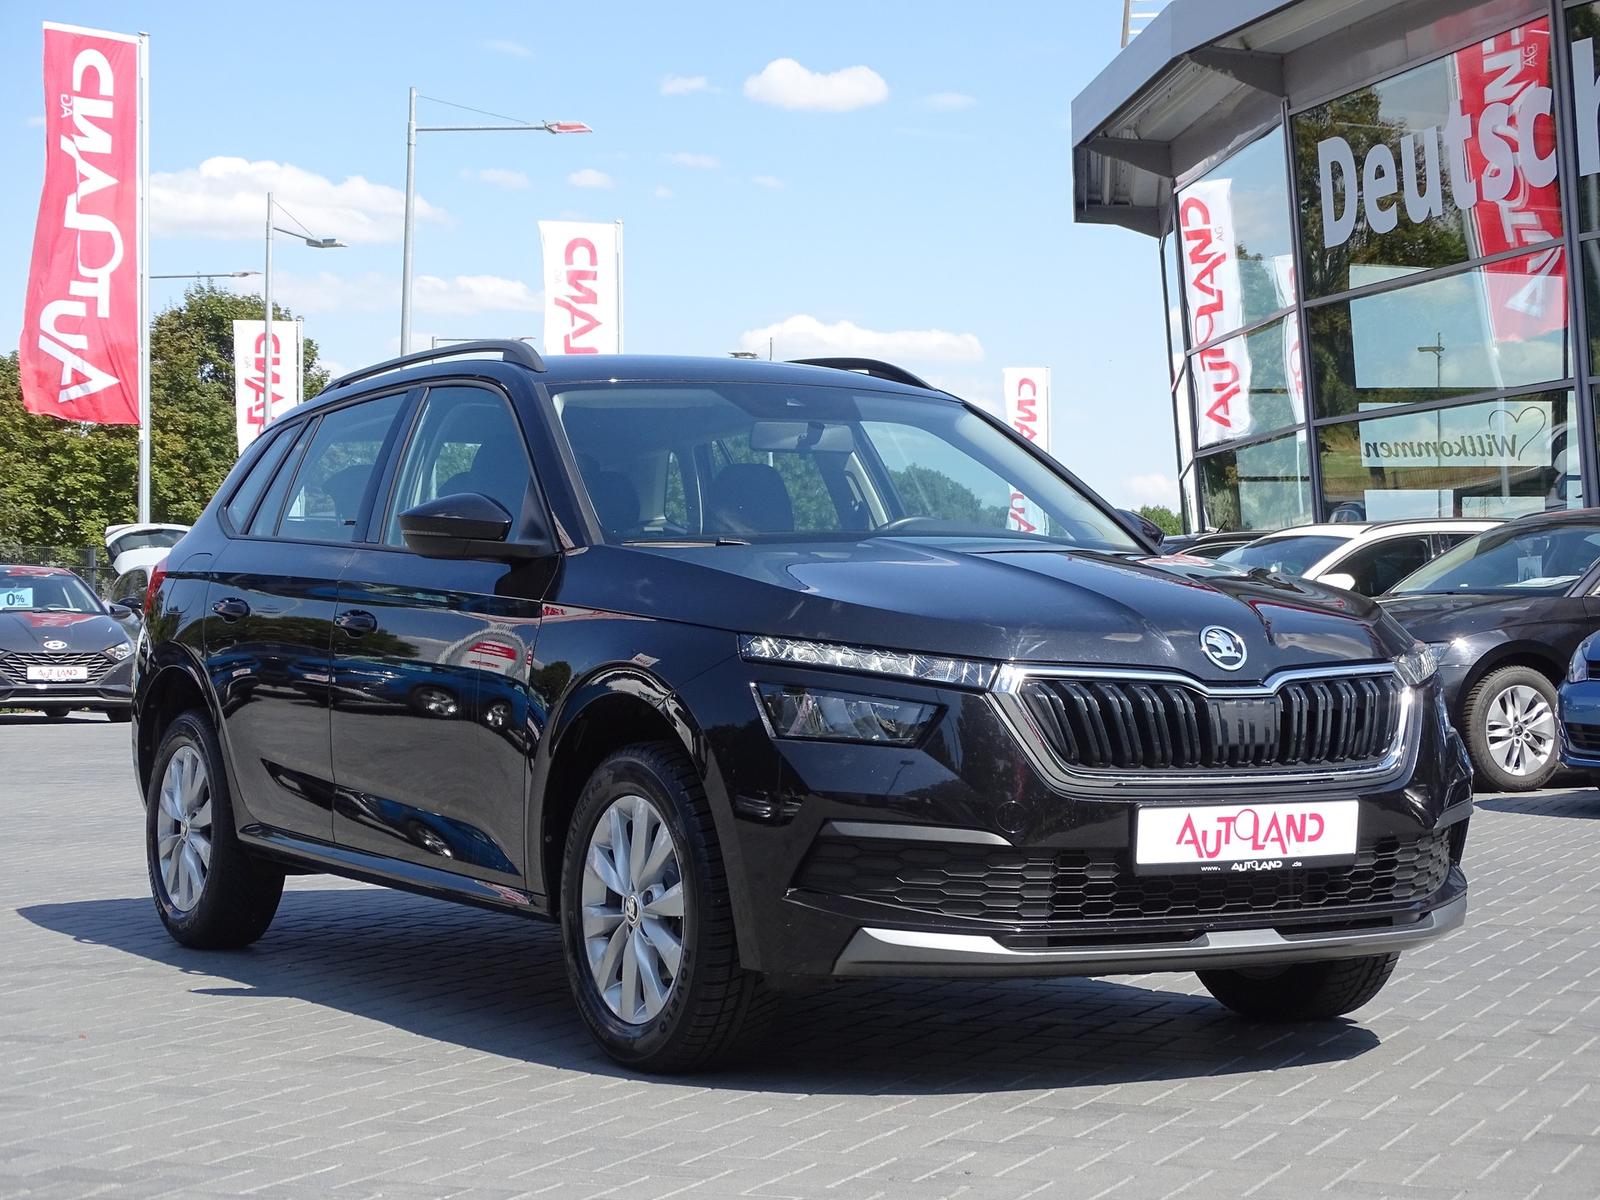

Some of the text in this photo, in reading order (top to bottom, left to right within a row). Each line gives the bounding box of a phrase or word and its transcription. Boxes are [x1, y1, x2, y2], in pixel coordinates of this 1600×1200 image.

[39, 669, 78, 678] AUTLAND
[1176, 809, 1325, 858] AUTOLAND
[1231, 860, 1282, 872] AUTOLAND
[660, 949, 691, 1033] ROVELO
